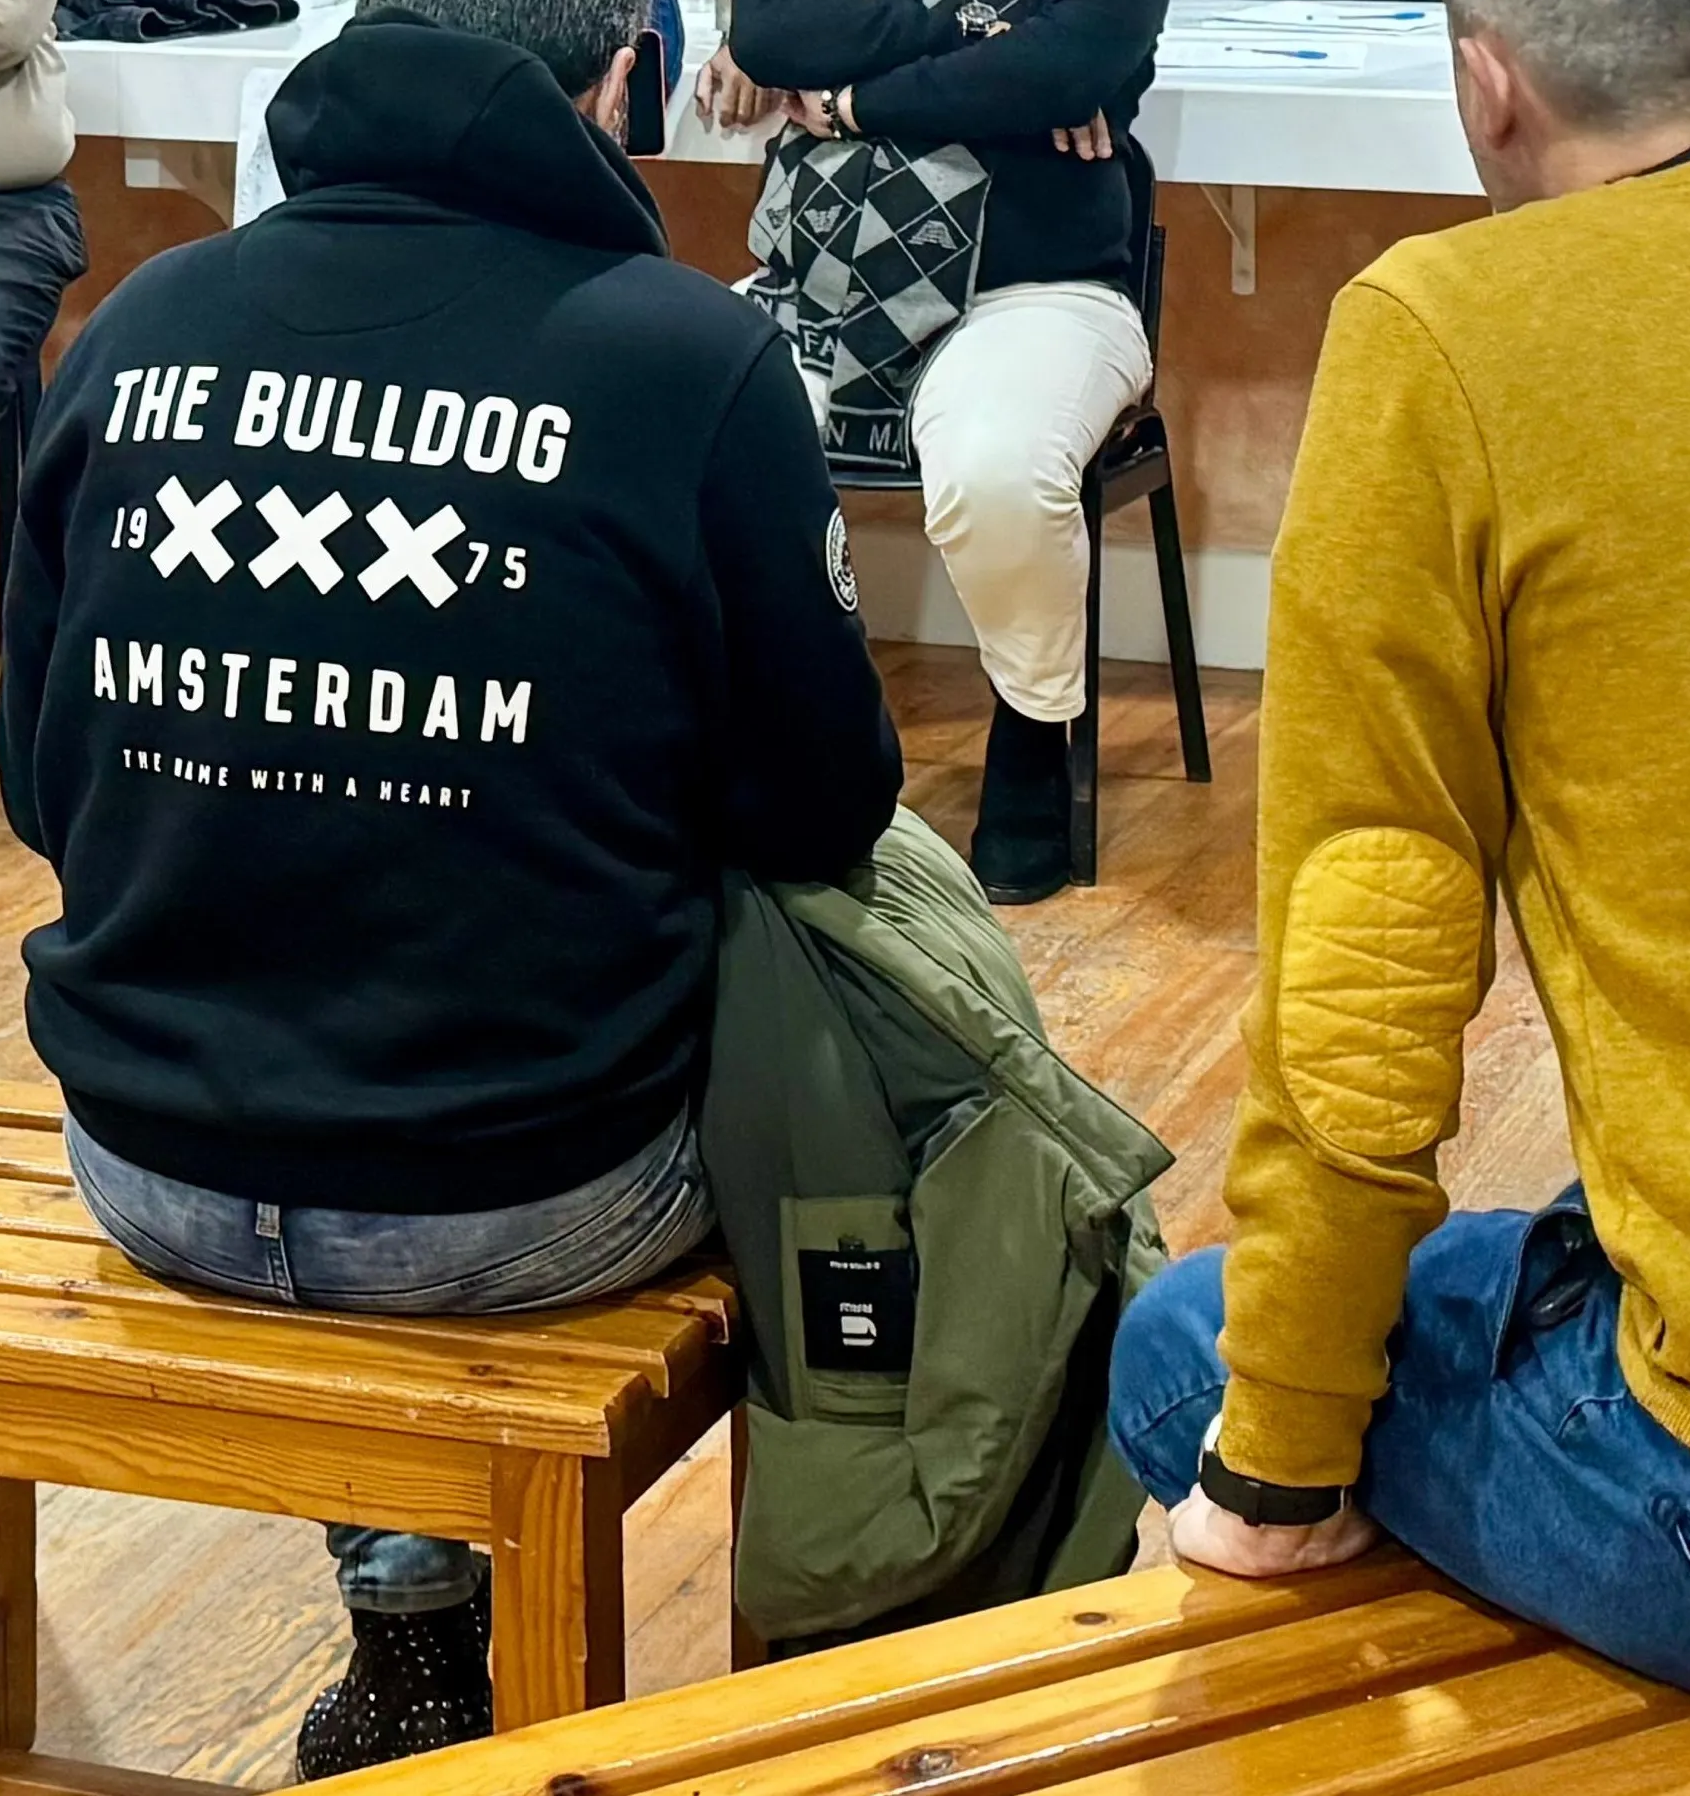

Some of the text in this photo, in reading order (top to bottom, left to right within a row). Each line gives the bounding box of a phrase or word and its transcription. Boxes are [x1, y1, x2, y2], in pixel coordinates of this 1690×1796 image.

[104, 365, 572, 484] THE BULLDOG
[110, 506, 148, 550] 19
[94, 636, 532, 745] AMSTERDAM
[123, 748, 162, 773] THE
[251, 769, 325, 794] WITH
[346, 776, 358, 798] A
[379, 780, 472, 809] HEART
